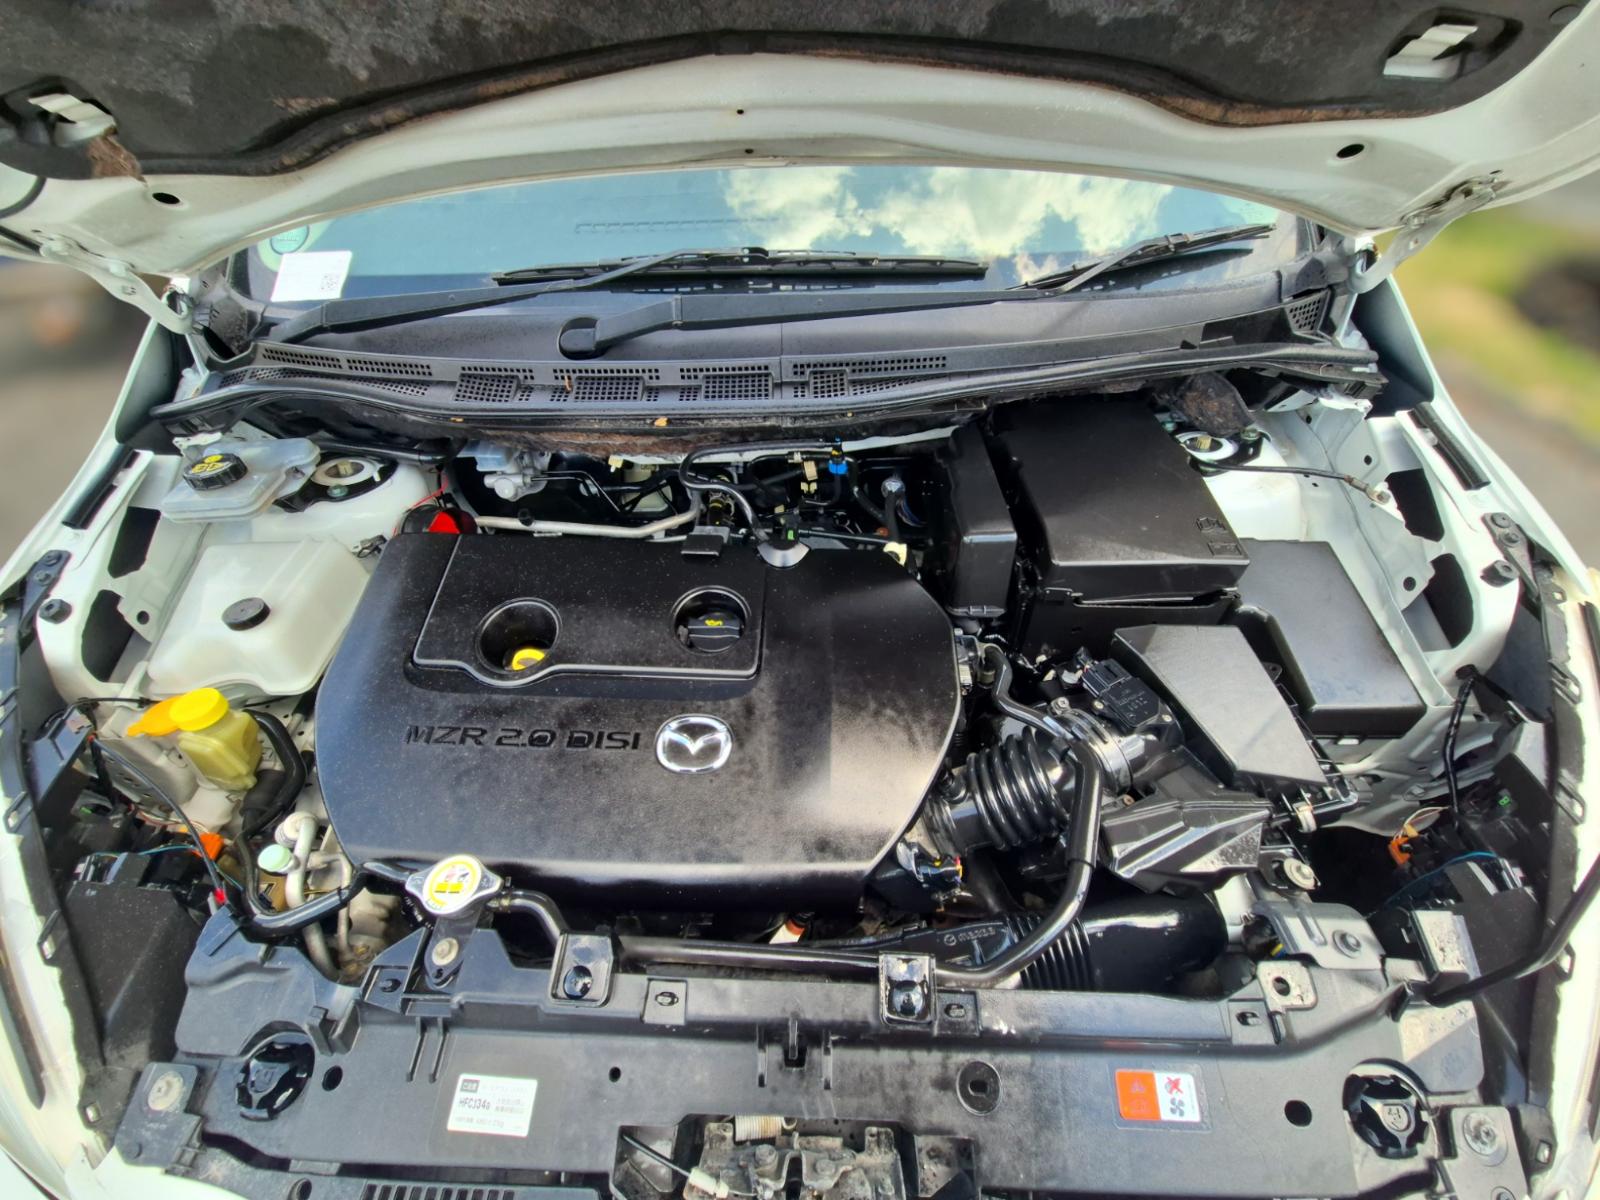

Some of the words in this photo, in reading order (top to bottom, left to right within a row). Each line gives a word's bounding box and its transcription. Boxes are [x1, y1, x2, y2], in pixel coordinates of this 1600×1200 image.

[406, 725, 488, 746] MZR
[495, 728, 557, 748] 2.0
[566, 730, 641, 750] DISI
